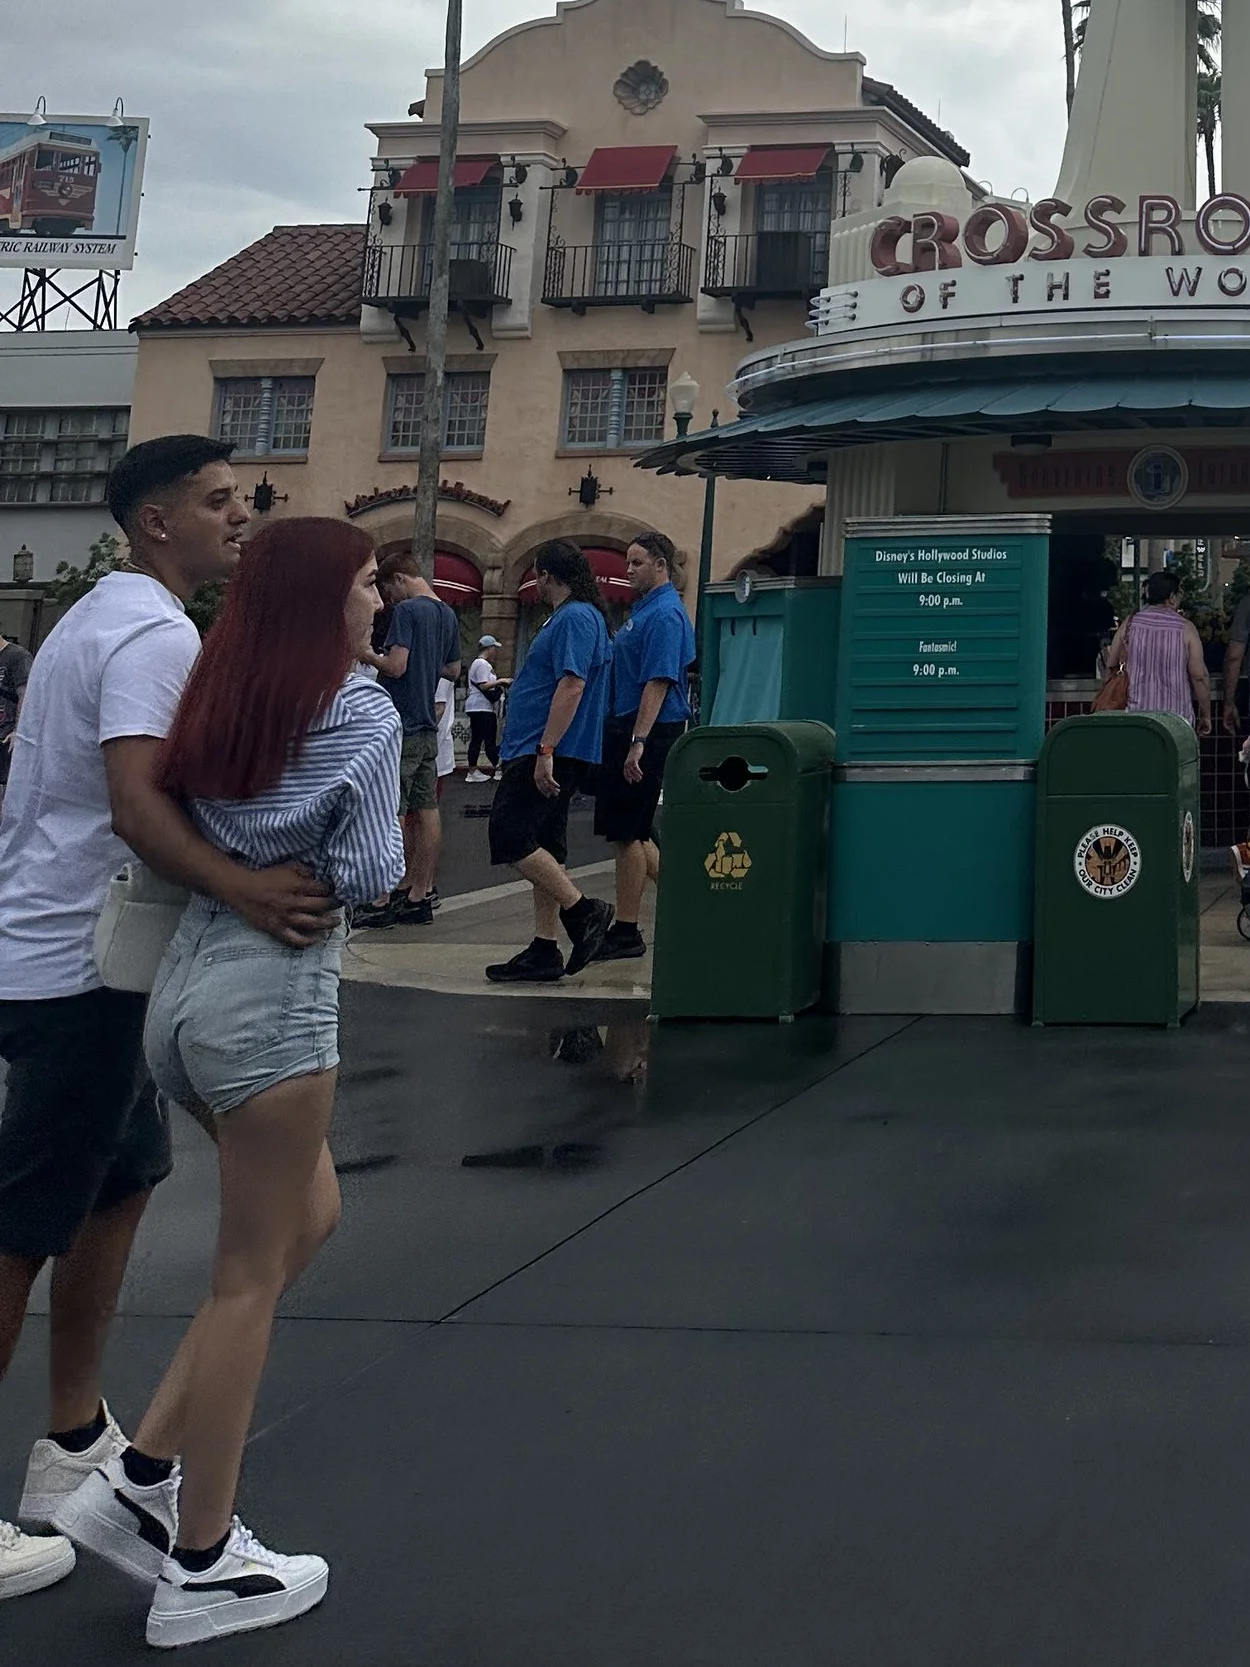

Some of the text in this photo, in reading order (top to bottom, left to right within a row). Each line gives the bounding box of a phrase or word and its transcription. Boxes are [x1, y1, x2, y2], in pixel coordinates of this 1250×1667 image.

[23, 241, 73, 254] RAILWAY
[73, 243, 117, 254] SYSTEM
[901, 279, 957, 313] OF
[1005, 268, 1111, 304] THE
[875, 547, 1007, 564] Disney's Hollywood Studios
[898, 571, 985, 585] Will Be Closing At
[919, 594, 963, 609] 9:00 p.m.
[919, 640, 957, 653] Fantasmic!
[913, 663, 960, 678] 9:00 p.m.
[1077, 827, 1138, 858] PLEASE HELP KEEP
[710, 881, 744, 891] RECYCLE
[1078, 868, 1137, 895] OUR CITY CLEAN
